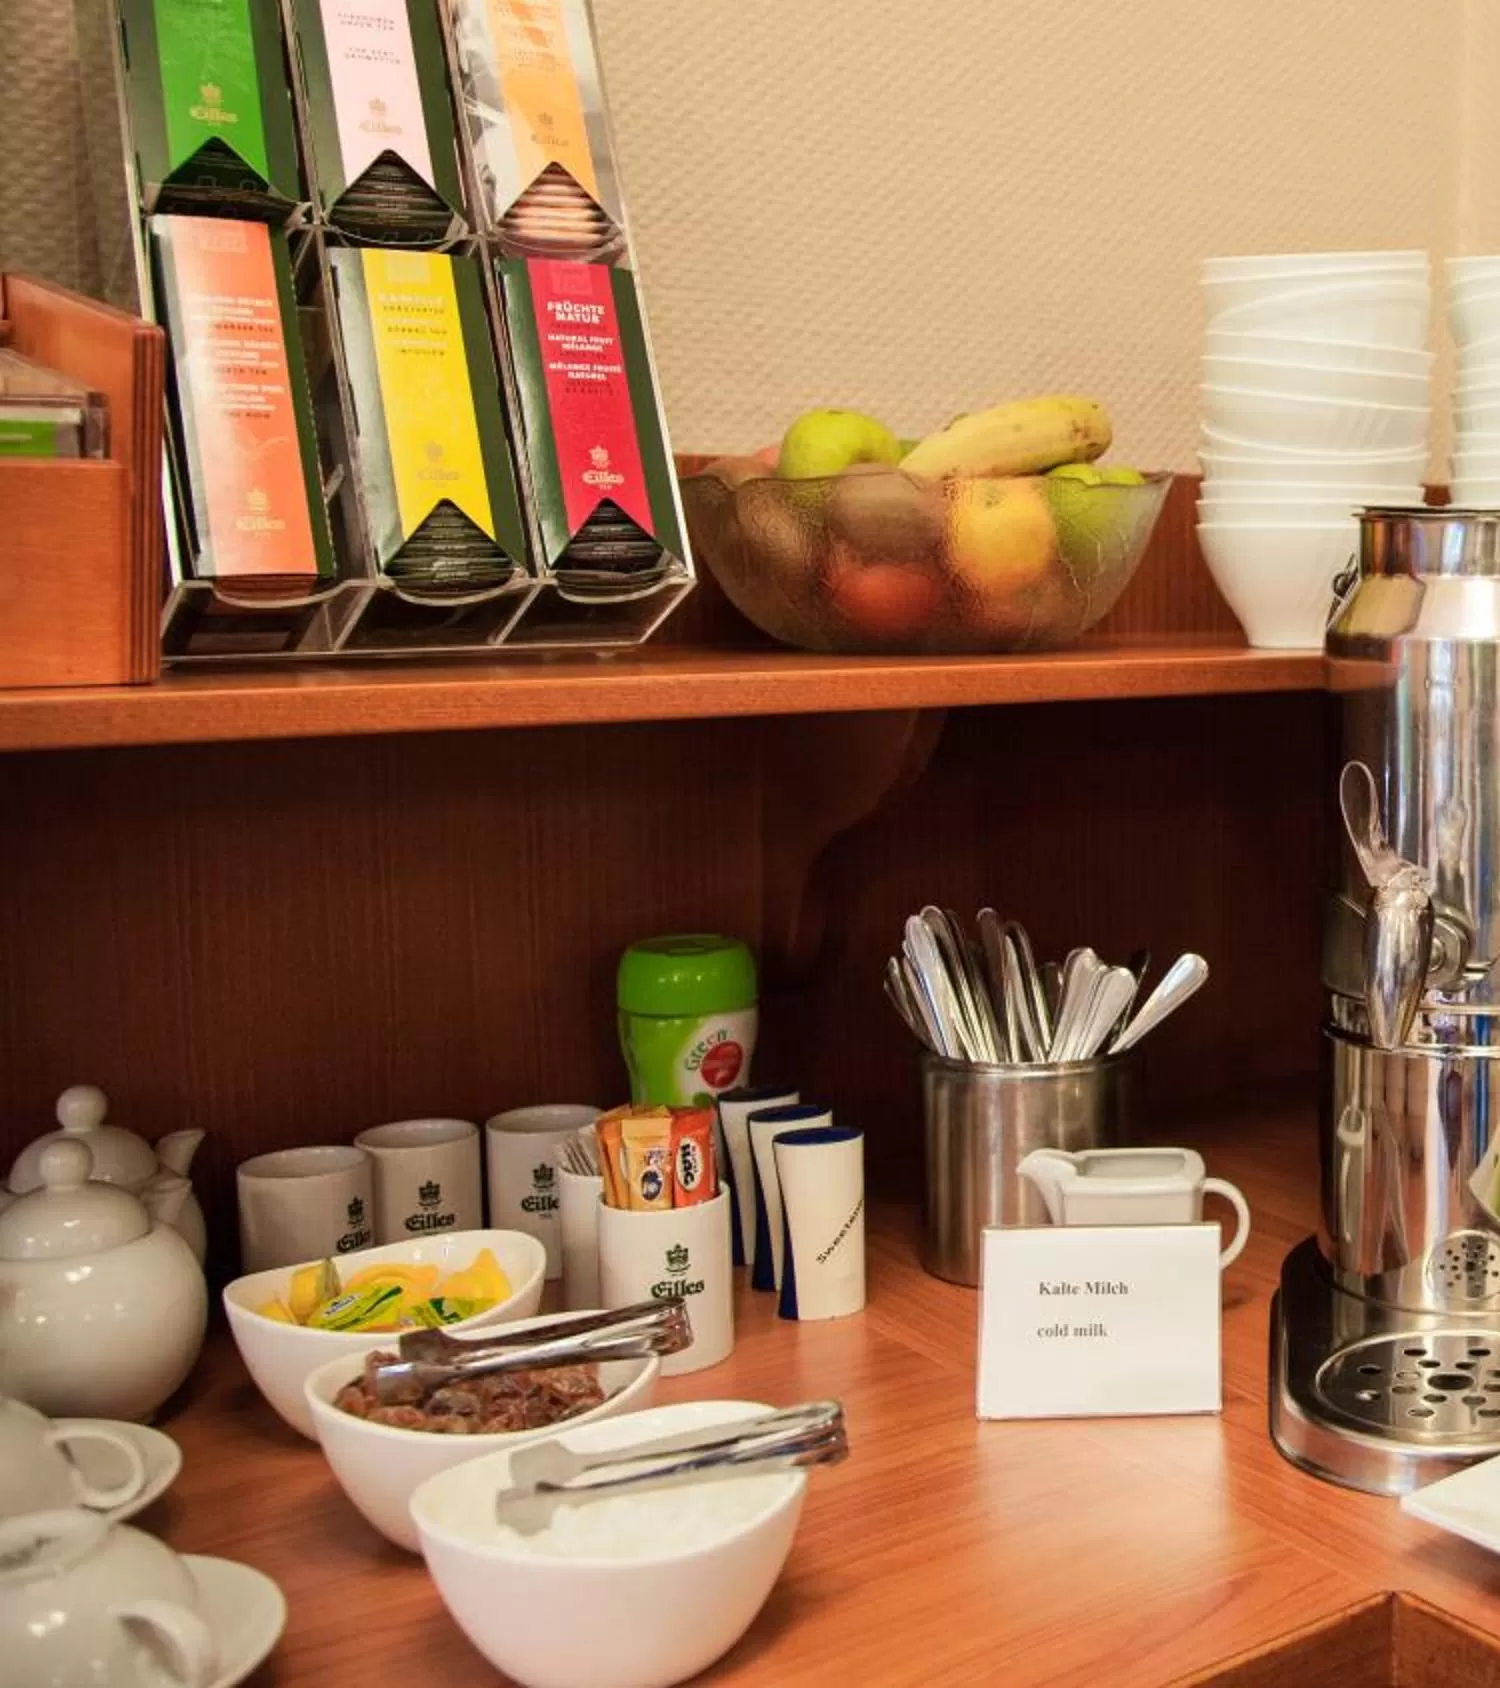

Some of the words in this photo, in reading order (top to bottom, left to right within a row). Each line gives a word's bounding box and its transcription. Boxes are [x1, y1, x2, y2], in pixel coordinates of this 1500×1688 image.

[547, 299, 605, 316] FRÜCHTE
[555, 311, 601, 324] NATUR
[581, 469, 624, 486] Eilles
[684, 1029, 729, 1072] Green
[404, 1212, 456, 1232] Eilles
[651, 1279, 704, 1299] Eilles
[1039, 1281, 1080, 1295] Kalte
[1085, 1281, 1128, 1295] Milch
[1037, 1323, 1069, 1337] cold
[1073, 1323, 1107, 1337] milk
